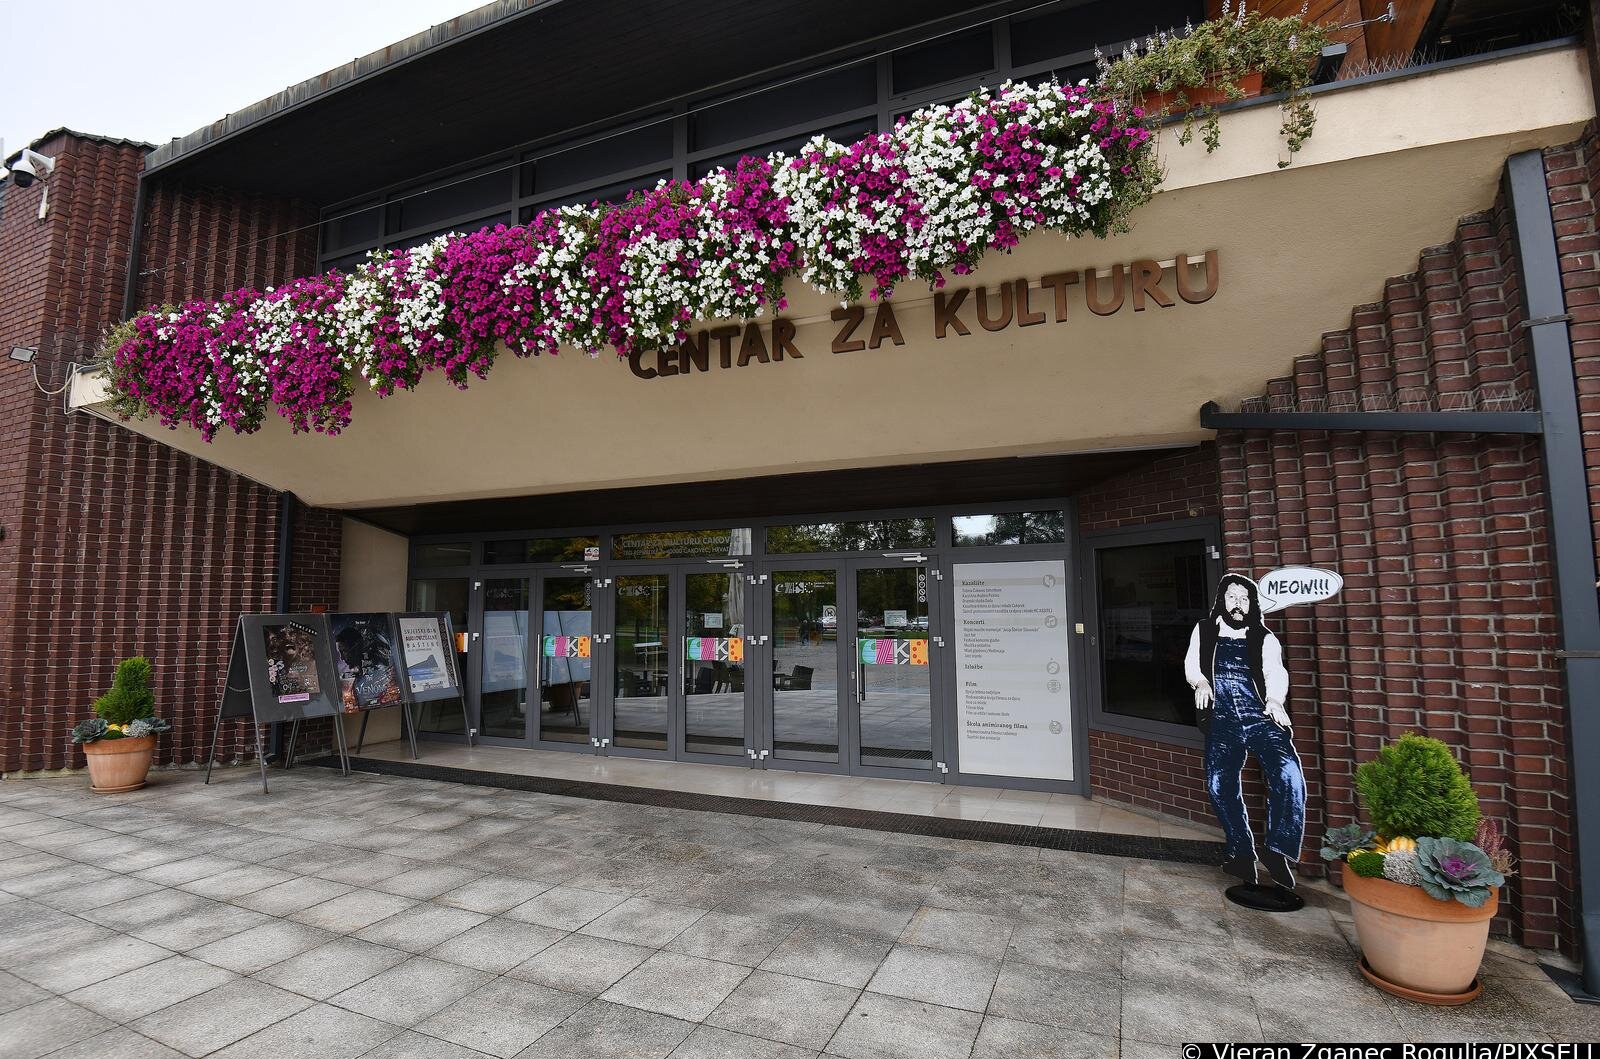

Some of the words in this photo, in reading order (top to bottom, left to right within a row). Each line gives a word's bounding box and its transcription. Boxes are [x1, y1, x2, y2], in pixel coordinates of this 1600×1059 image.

[629, 318, 804, 380] CENTAR
[831, 300, 905, 353] ZA
[934, 249, 1219, 339] KULTURU
[1268, 579, 1329, 595] MEOW!!!
